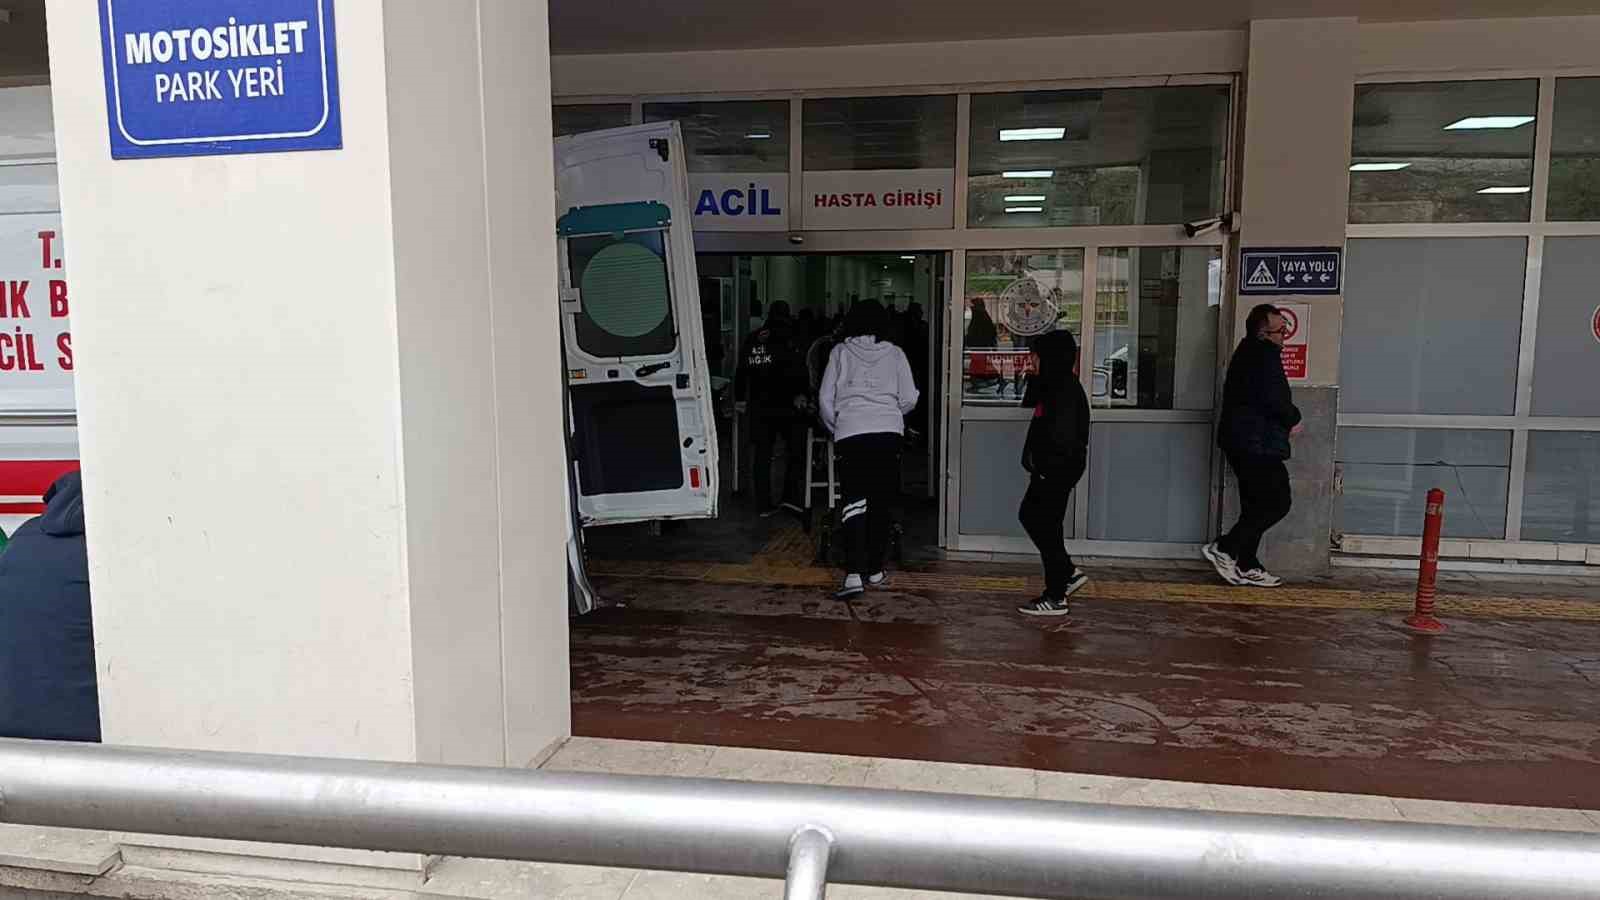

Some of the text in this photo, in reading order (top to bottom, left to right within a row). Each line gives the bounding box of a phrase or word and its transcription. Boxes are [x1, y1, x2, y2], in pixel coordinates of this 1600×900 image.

[125, 17, 308, 64] MOTOSİKLET
[155, 59, 284, 103] PARK YERİ
[694, 183, 781, 216] ACİL
[814, 188, 943, 209] HASTA GİRİŞİ
[38, 230, 61, 269] T.
[1281, 260, 1335, 273] YAYA YOLU
